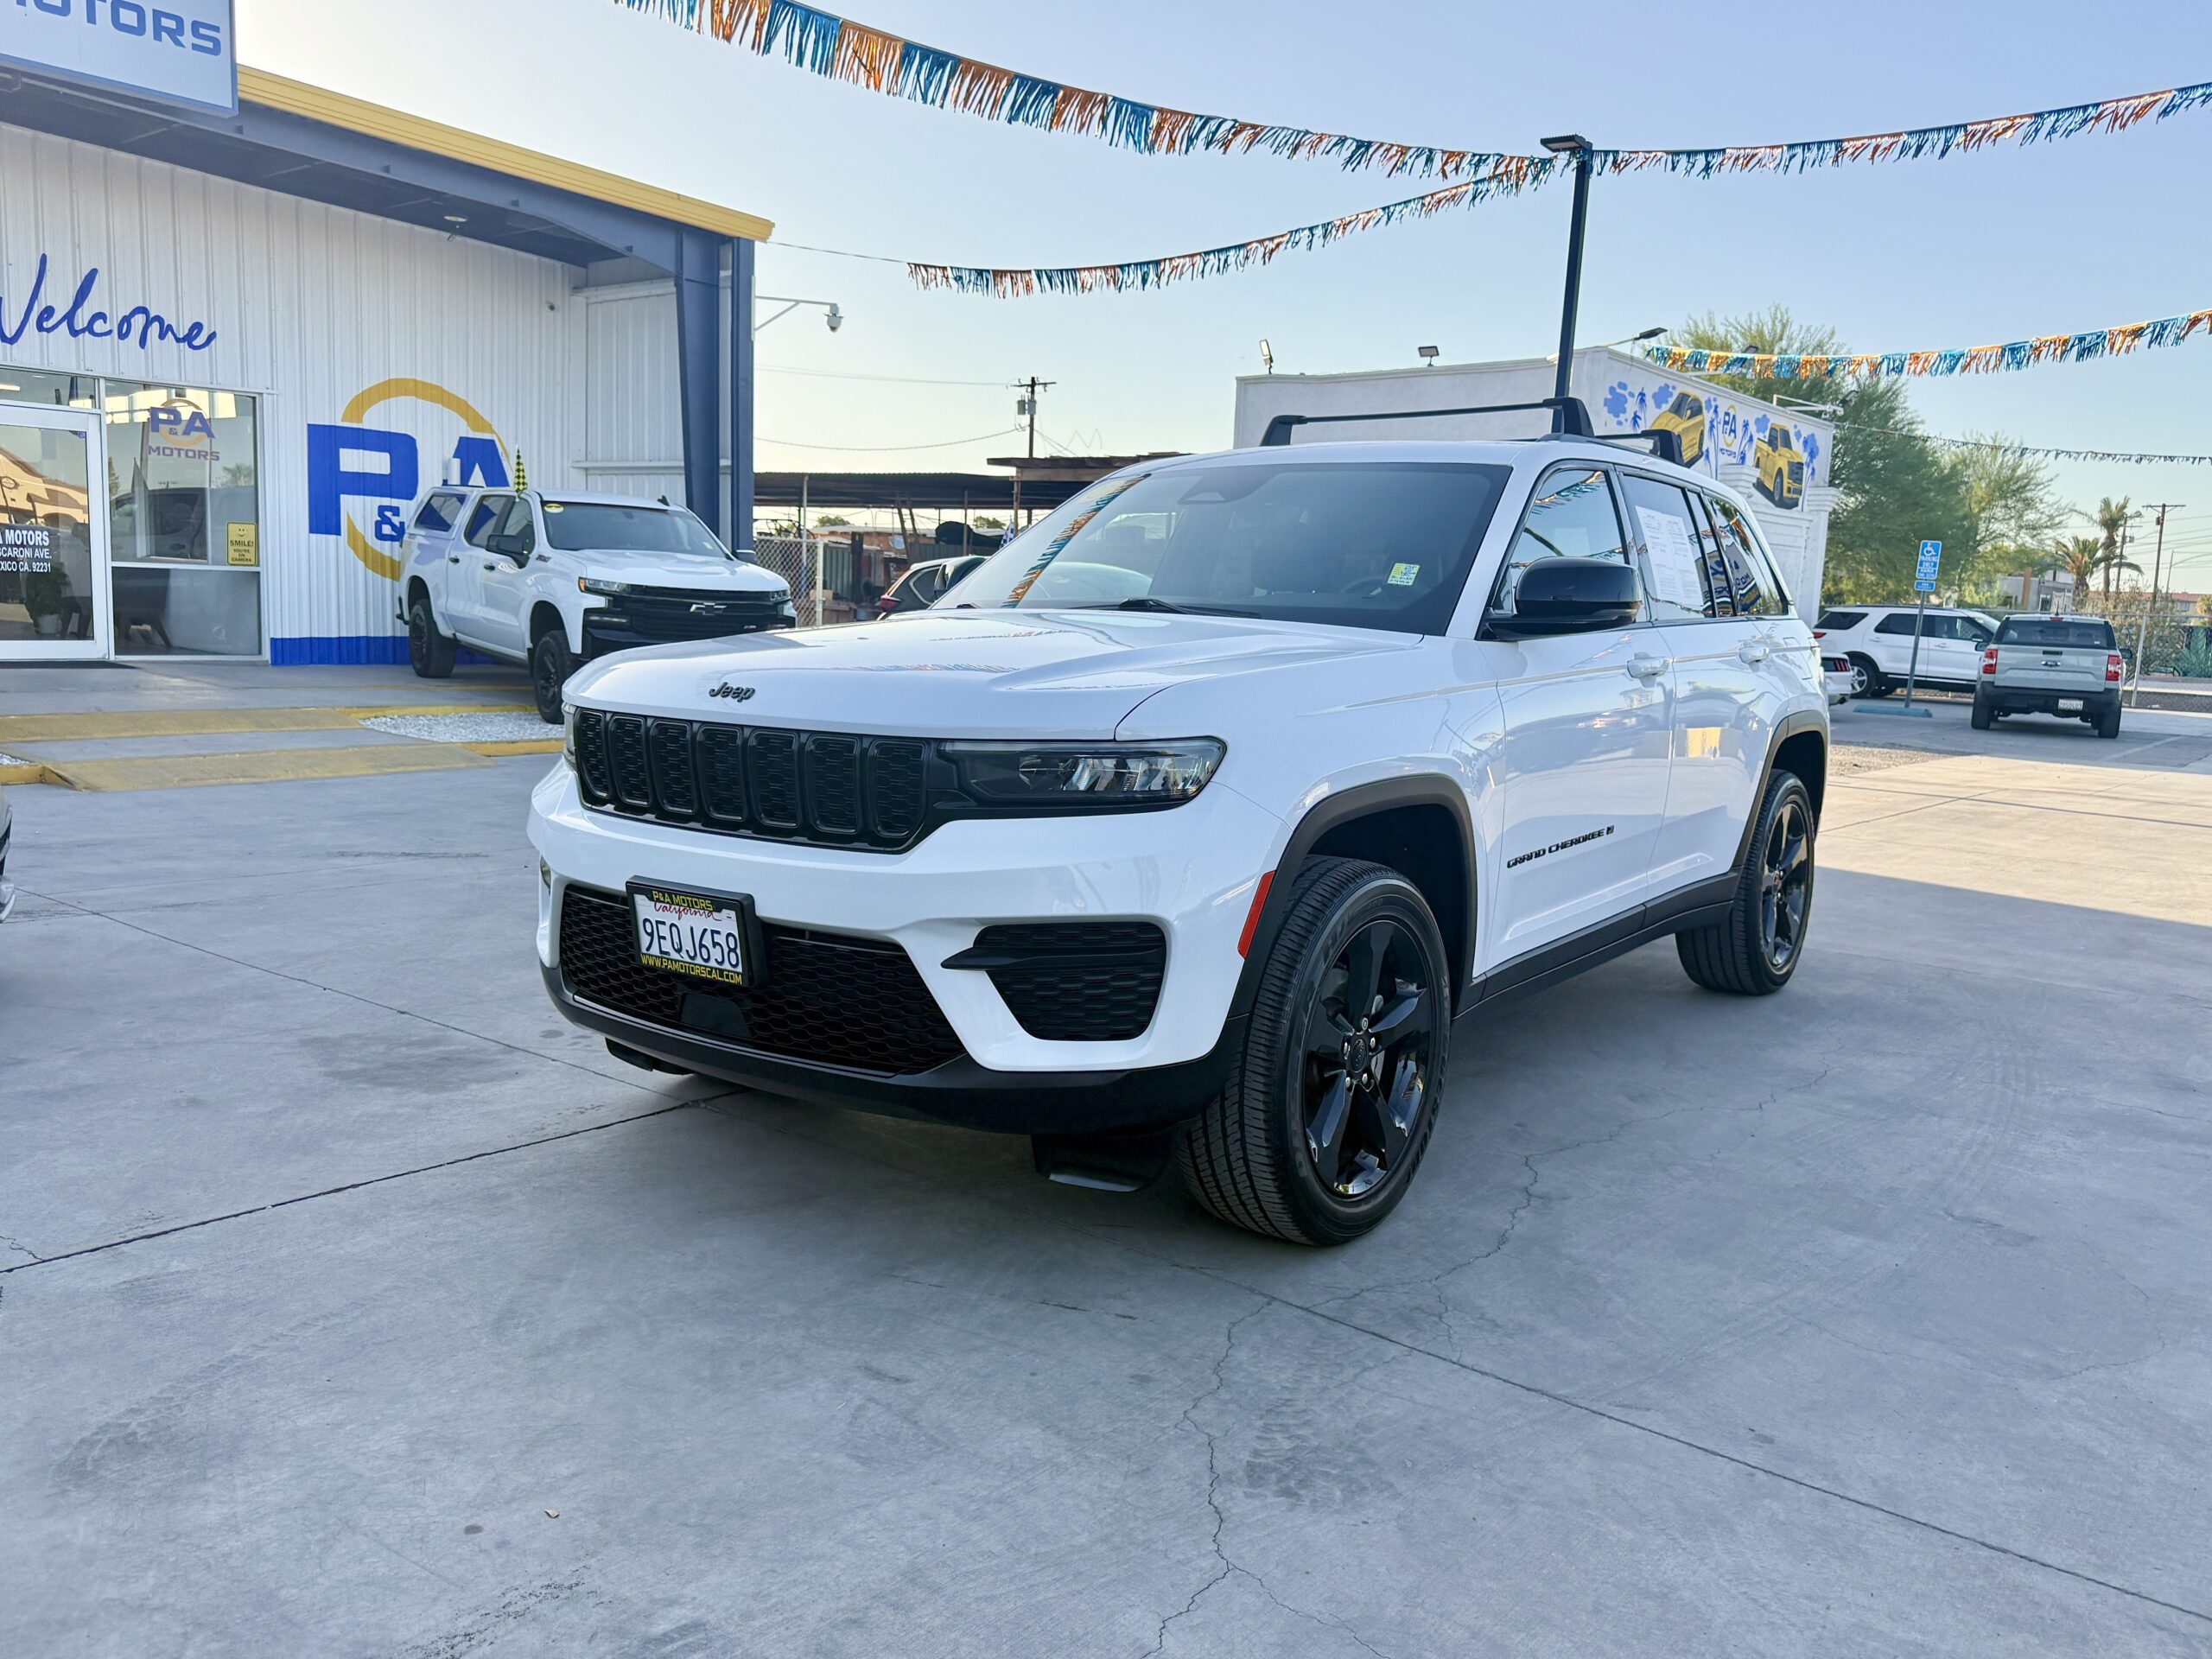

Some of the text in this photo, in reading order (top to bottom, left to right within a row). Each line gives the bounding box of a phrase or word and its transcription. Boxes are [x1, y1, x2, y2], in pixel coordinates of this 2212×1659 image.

[16, 0, 222, 57] TORS
[149, 405, 216, 440] P&A
[148, 444, 220, 462] MOTORS
[5, 529, 50, 547] MOTORS
[230, 539, 254, 548] SMILE!
[35, 548, 53, 560] AVE.
[0, 560, 51, 574] XICO CA. 92231
[709, 681, 757, 703] Jeep
[1506, 828, 1605, 869] GRAND CHEROKEE
[652, 890, 714, 911] P&A MOTORS
[642, 918, 741, 969] 9EQJ658
[640, 953, 743, 985] WWW.PAMOTORSCAL.COM
